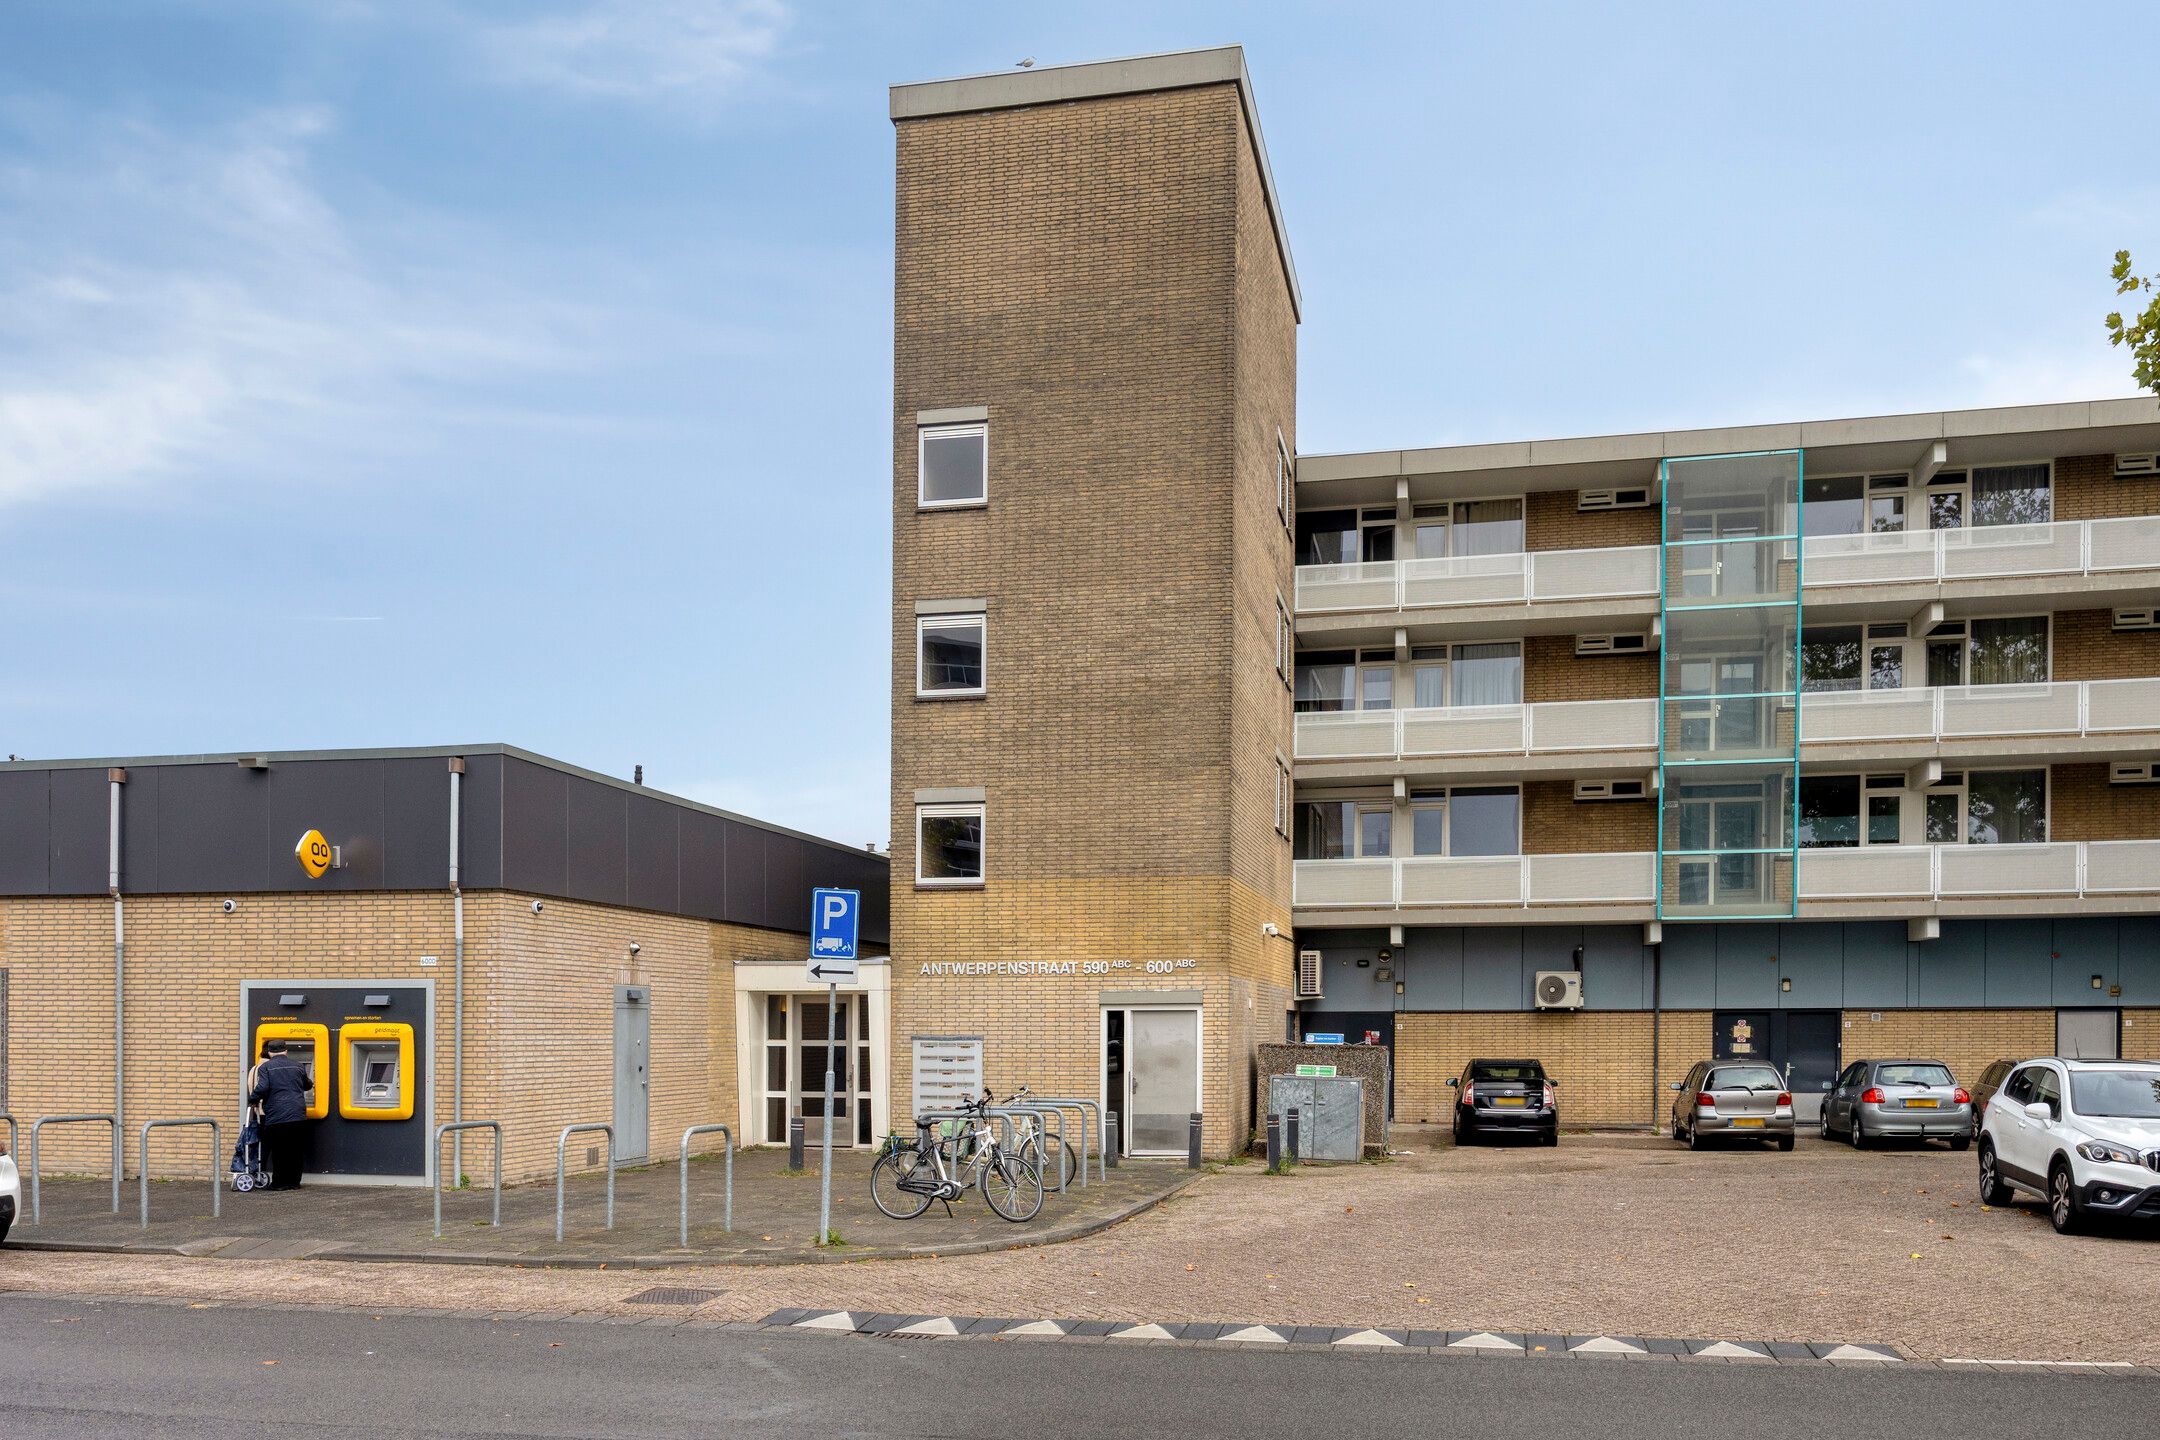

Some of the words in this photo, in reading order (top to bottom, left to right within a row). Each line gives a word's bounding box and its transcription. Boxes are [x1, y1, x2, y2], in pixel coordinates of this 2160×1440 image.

[823, 896, 848, 930] P
[920, 961, 1078, 975] ANTWERPENSTRAAT
[1082, 960, 1109, 974] 590
[1111, 959, 1132, 968] ABC
[1146, 960, 1173, 974] 600
[1175, 959, 1196, 968] ABC
